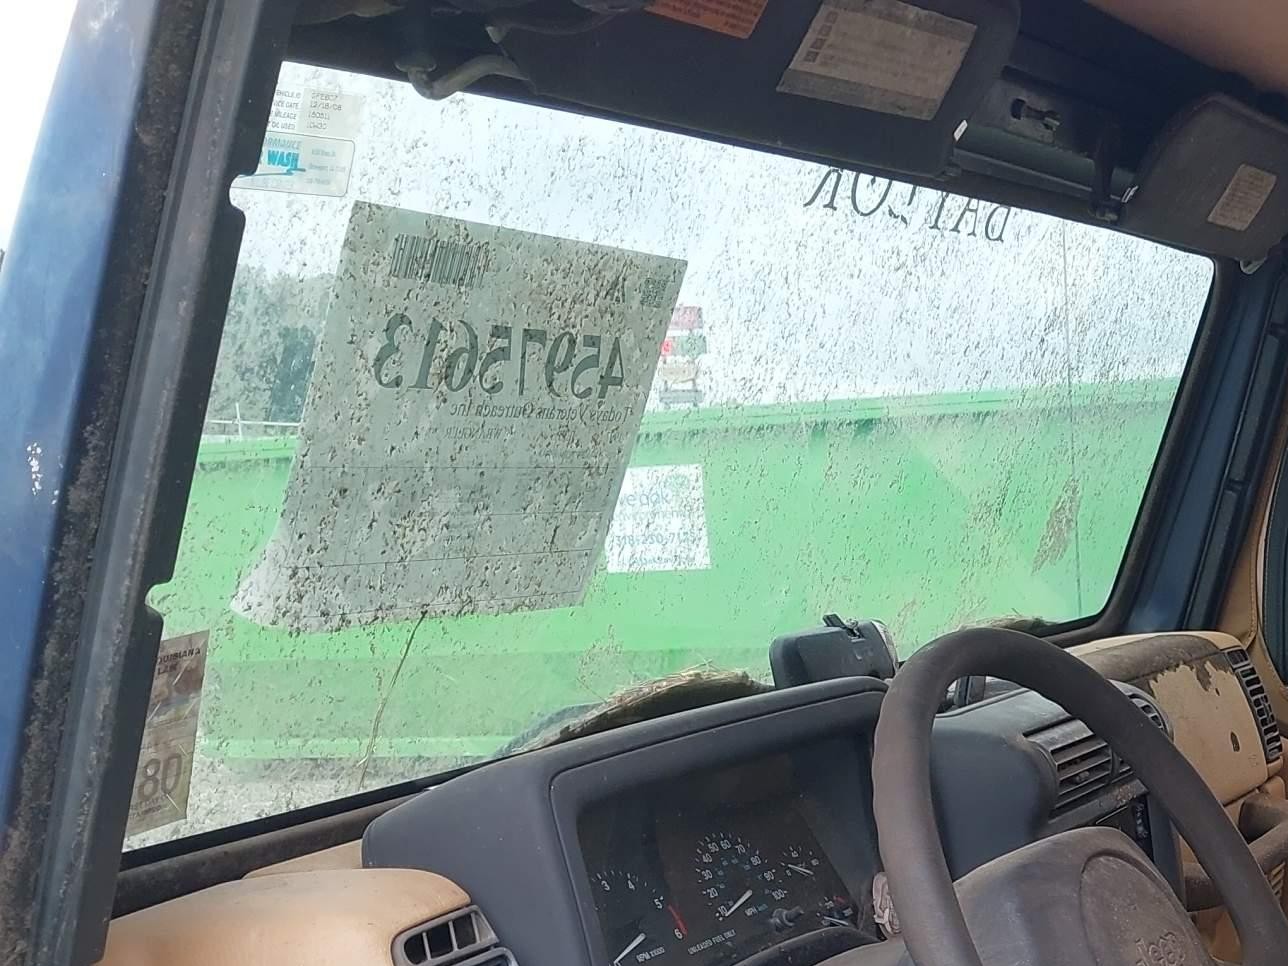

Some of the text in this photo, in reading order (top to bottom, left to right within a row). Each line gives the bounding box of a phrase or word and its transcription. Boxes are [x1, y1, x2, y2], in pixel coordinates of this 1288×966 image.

[267, 149, 299, 169] WASH
[708, 842, 719, 852] 50
[720, 839, 731, 849] 60
[735, 844, 746, 854] 70
[702, 853, 713, 863] 40
[751, 855, 761, 865] 80
[702, 869, 713, 880] 30
[763, 871, 774, 881] 90
[601, 880, 610, 891] 3
[627, 880, 635, 890] 4
[707, 887, 718, 898] 20
[772, 889, 785, 900] 100
[654, 899, 663, 909] 5
[674, 929, 683, 939] 6
